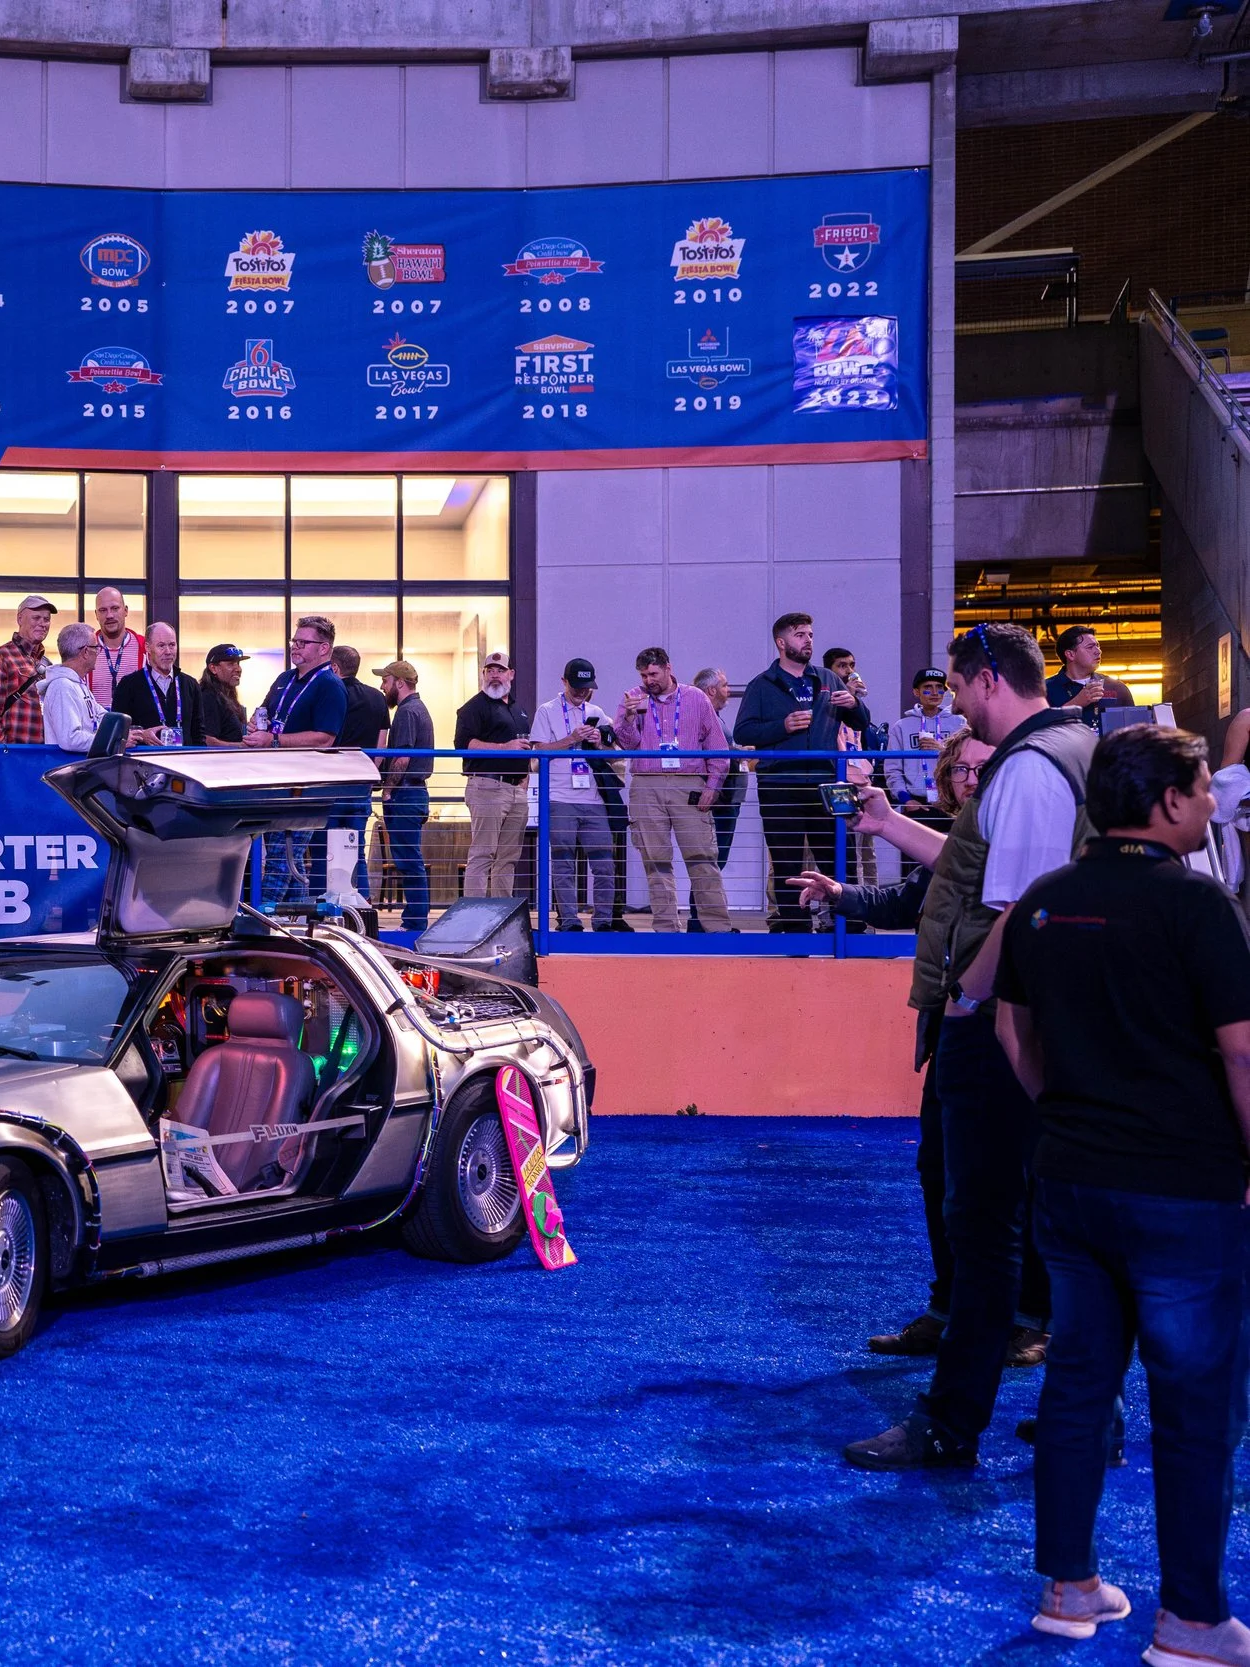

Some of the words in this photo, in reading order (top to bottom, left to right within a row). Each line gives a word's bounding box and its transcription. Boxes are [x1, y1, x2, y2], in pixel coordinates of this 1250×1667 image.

[825, 227, 868, 241] FRISCO
[97, 248, 134, 267] mpc
[397, 247, 441, 255] Sheraton
[526, 259, 562, 268] Poinsettia
[681, 266, 708, 274] FIESTA
[710, 265, 734, 273] BOWL
[101, 268, 129, 277] BOWL
[402, 269, 435, 280] BOWL
[235, 277, 261, 285] FIESTA
[262, 277, 285, 285] BOWL
[674, 288, 742, 304] 2010
[809, 281, 878, 298] 2022
[81, 297, 148, 313] 2005
[226, 300, 294, 314] 2007
[373, 300, 441, 314] 2007
[520, 297, 590, 313] 2008
[251, 340, 269, 366] 6
[533, 343, 574, 351] SERVPRO
[90, 368, 123, 376] Poinsettia
[125, 369, 142, 377] Bowl
[229, 365, 290, 382] CACTUS
[375, 371, 398, 380] LAS
[402, 371, 442, 380] VEGAS
[671, 366, 687, 374] LAS
[689, 365, 717, 373] VEGAS
[720, 364, 746, 372] BOWL
[238, 378, 282, 390] BOWL
[515, 374, 594, 385] RESPONDER
[391, 380, 425, 397] Bowl
[541, 386, 568, 394] BOWL
[674, 395, 741, 411] 2019
[805, 388, 880, 407] 2023
[83, 403, 145, 418] 2015
[228, 405, 291, 419] 2016
[375, 406, 439, 420] 2017
[522, 404, 587, 419] 2018
[1119, 844, 1146, 855] VIP
